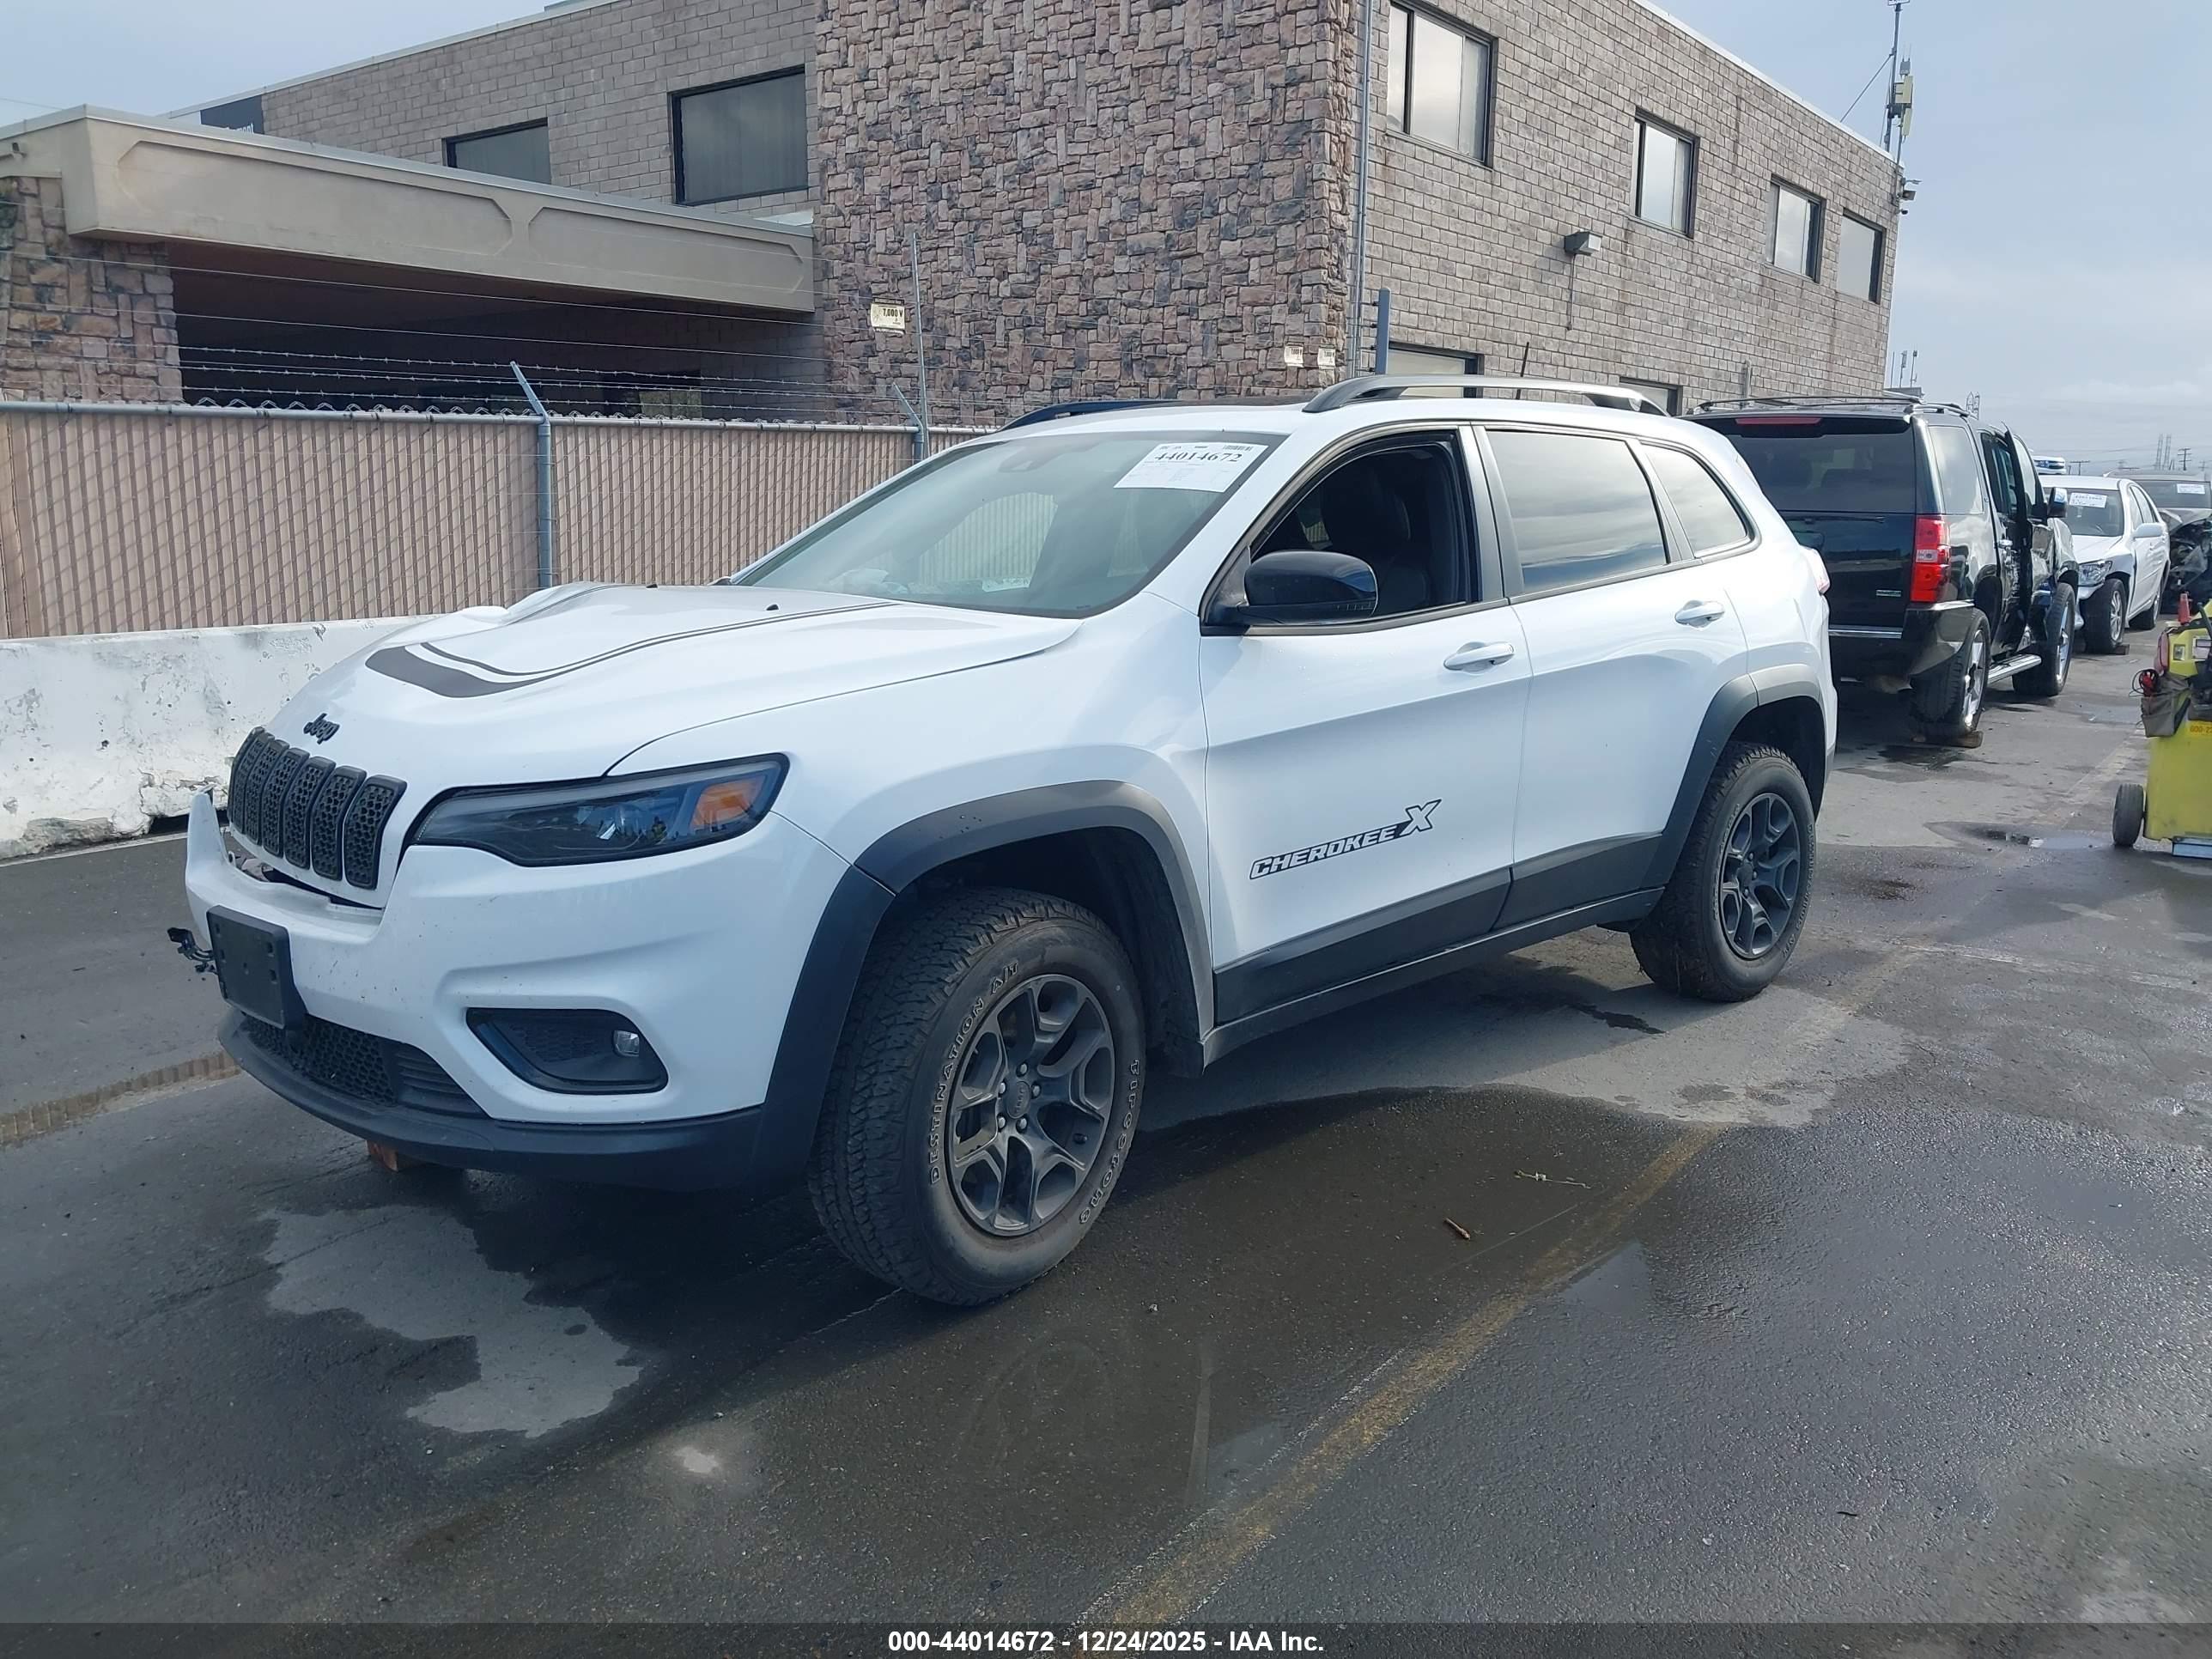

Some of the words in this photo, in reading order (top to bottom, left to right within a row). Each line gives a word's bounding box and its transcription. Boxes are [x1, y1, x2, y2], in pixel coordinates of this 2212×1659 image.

[883, 308, 898, 317] 7,000
[1154, 452, 1243, 463] 44014672
[303, 713, 340, 744] Jeep
[1249, 825, 1400, 879] CHEROKEE
[928, 996, 986, 1185] DESTINATION
[990, 959, 1020, 996] A/T
[1079, 1058, 1141, 1224] Firestone
